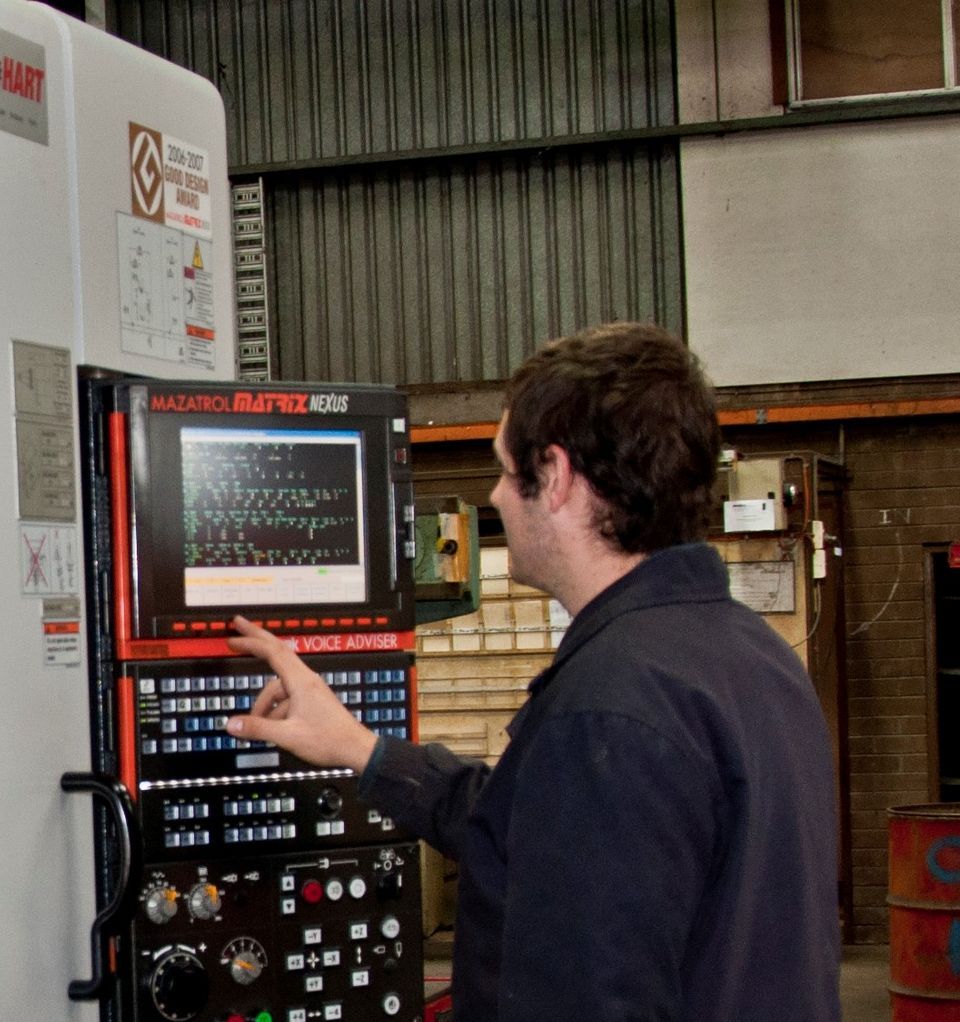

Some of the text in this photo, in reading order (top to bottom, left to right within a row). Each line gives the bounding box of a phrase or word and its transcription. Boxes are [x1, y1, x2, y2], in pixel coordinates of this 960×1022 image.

[1, 55, 45, 104] HART
[166, 143, 204, 172] 2006-2007
[164, 163, 209, 195] GOOD DESIGN
[175, 187, 200, 211] AWARD
[150, 391, 349, 414] MAZATROL MATRIX NEXUS
[302, 635, 342, 651] VOICE
[346, 633, 398, 651] ADVISER
